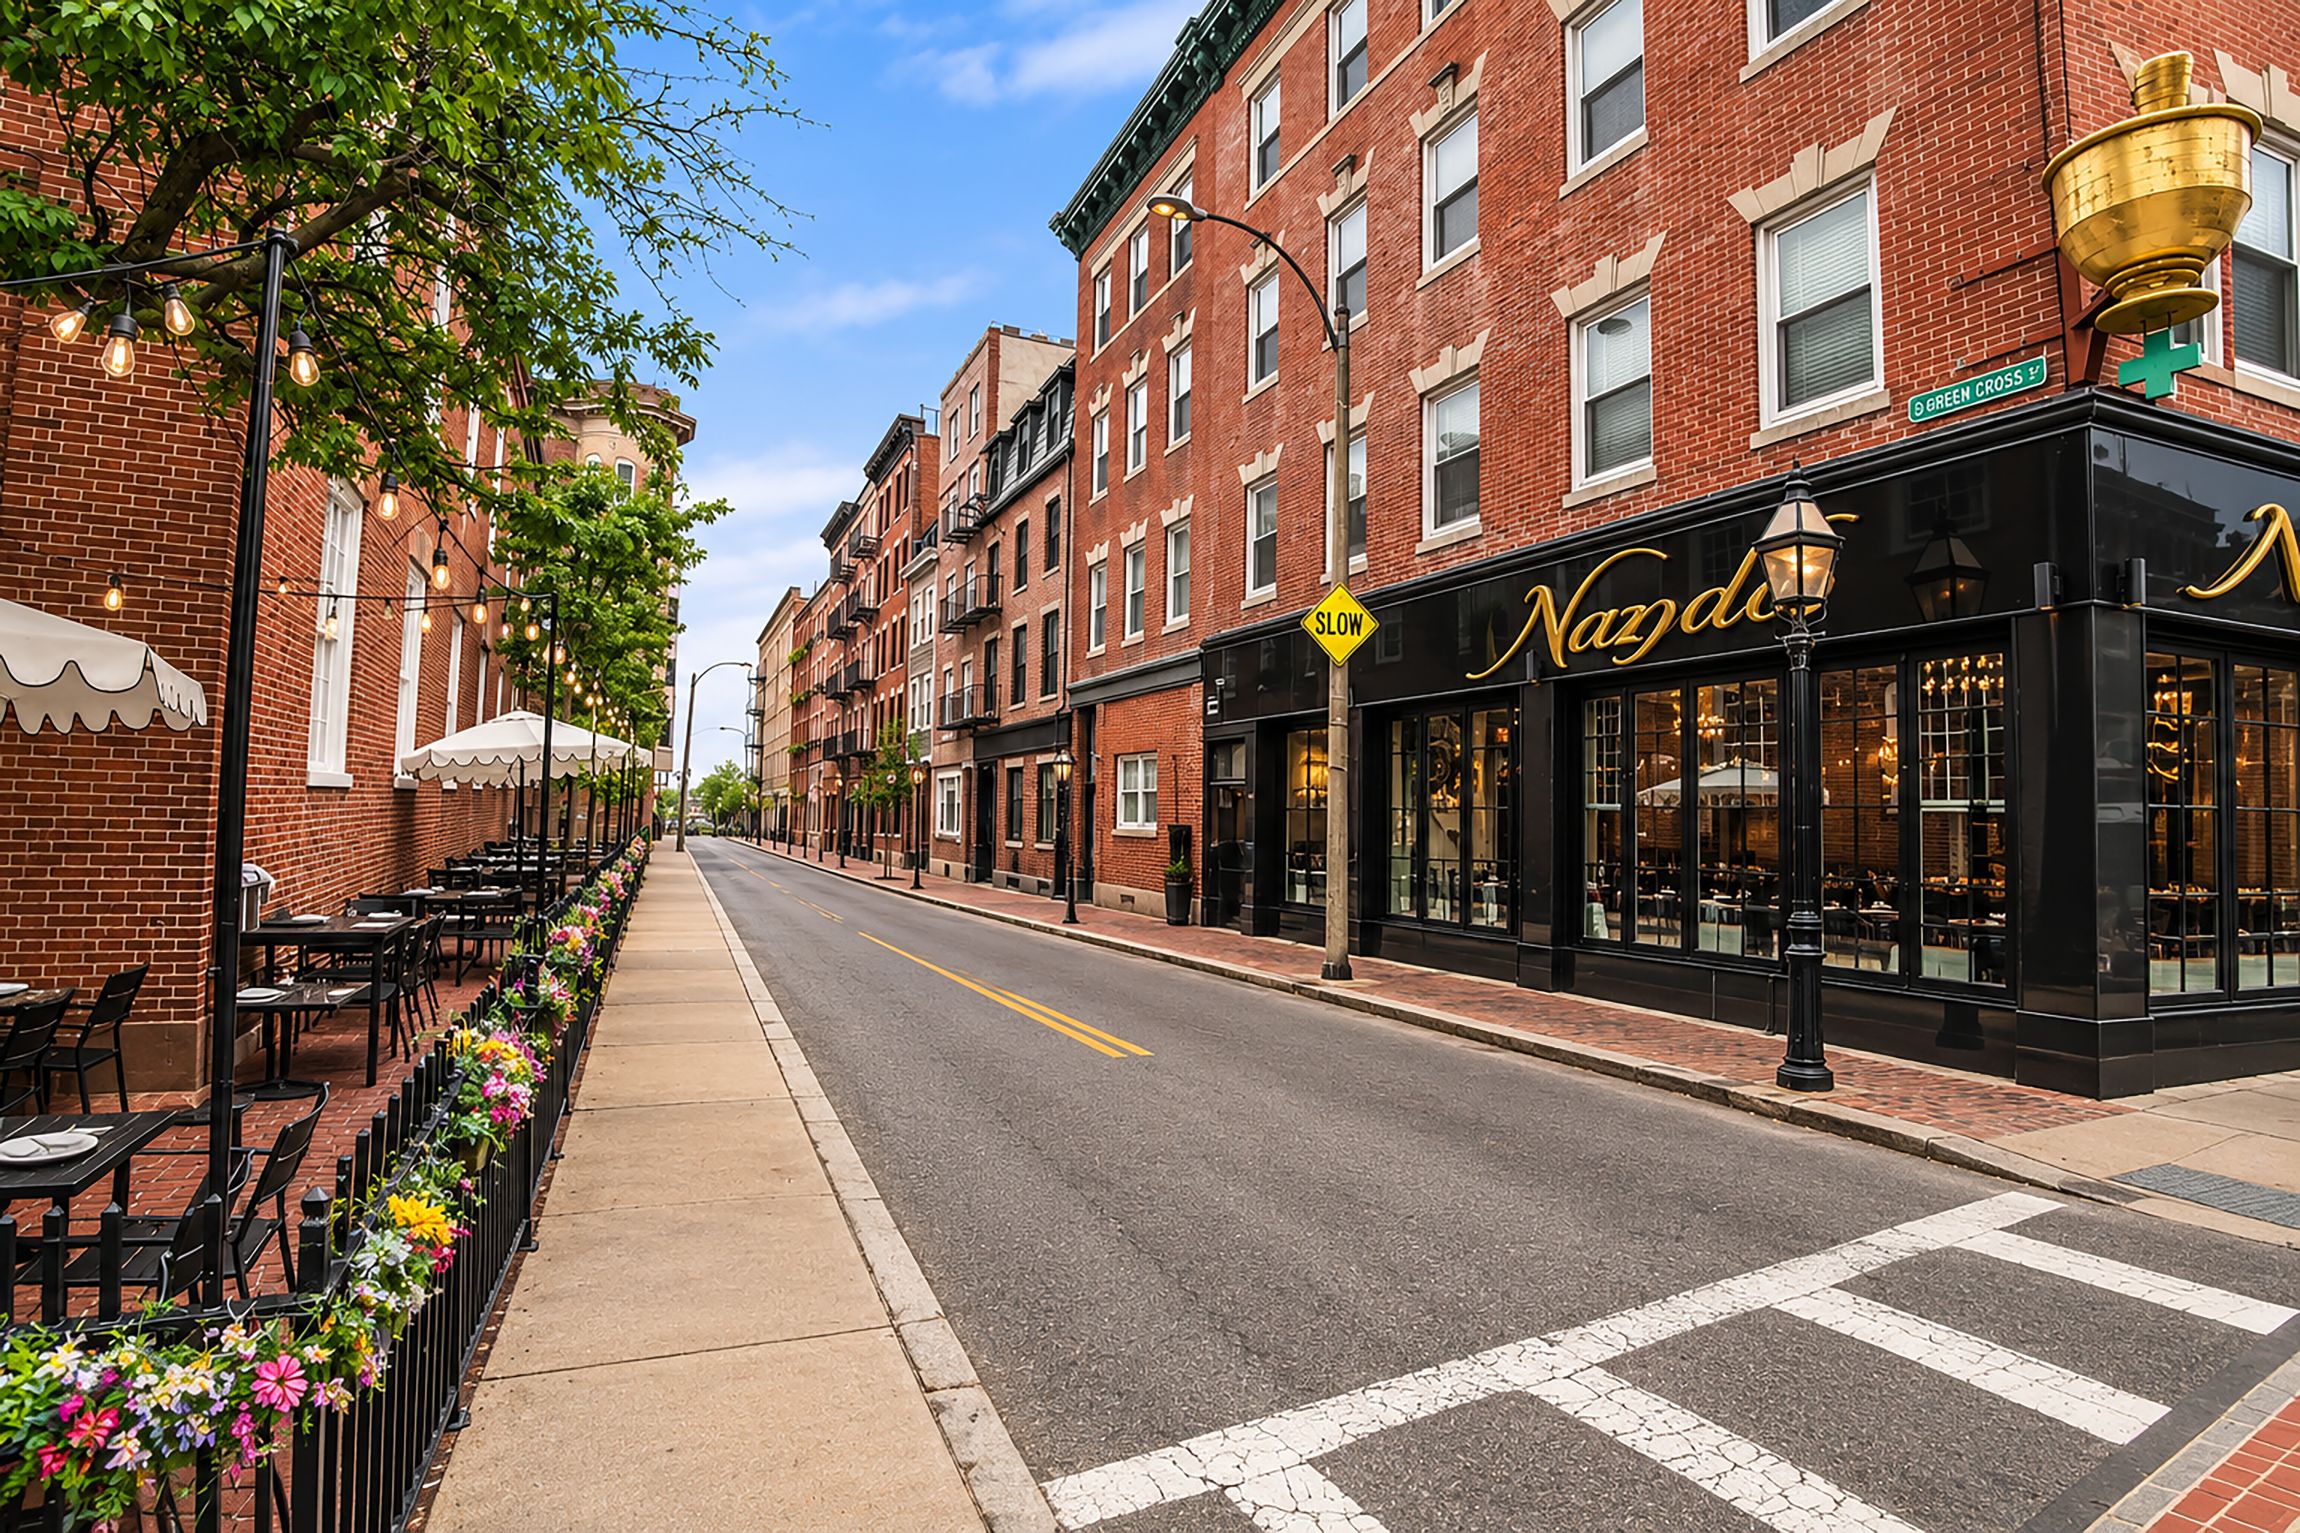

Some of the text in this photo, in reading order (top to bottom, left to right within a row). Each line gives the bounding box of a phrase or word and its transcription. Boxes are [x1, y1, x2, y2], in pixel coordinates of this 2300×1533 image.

[1926, 386, 1971, 412] GREEN
[1975, 369, 2023, 398] CROSS
[1315, 611, 1363, 636] SLOW
